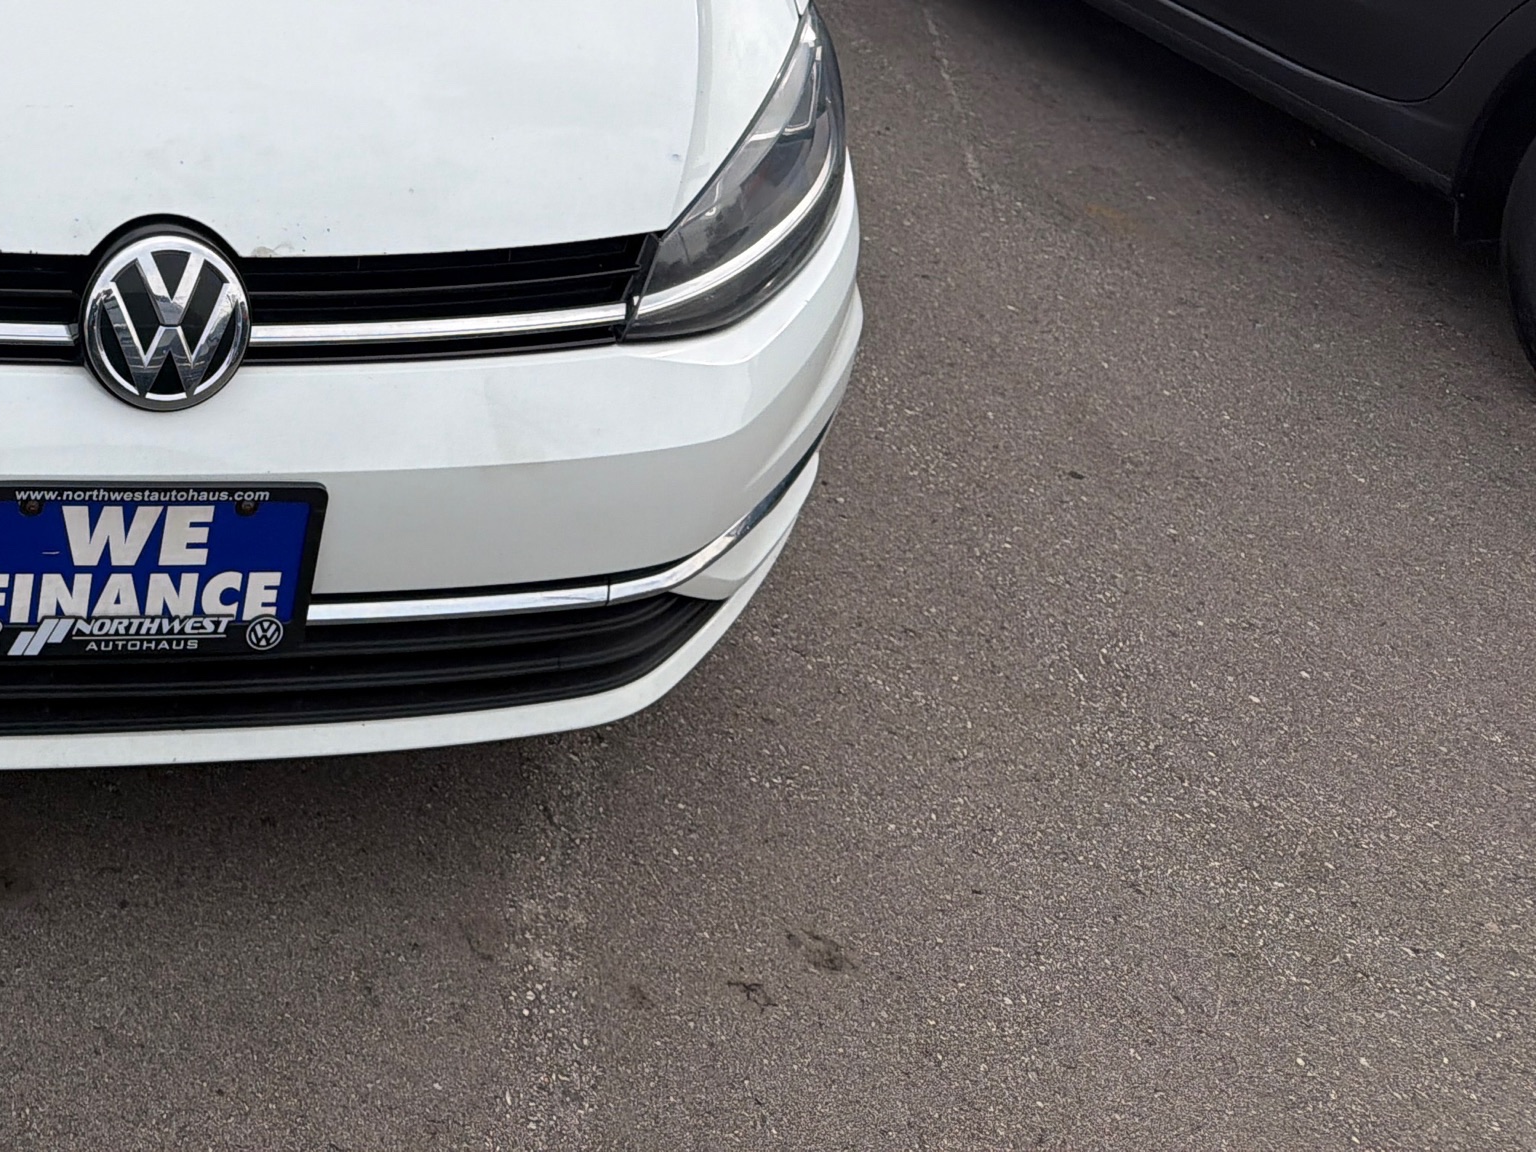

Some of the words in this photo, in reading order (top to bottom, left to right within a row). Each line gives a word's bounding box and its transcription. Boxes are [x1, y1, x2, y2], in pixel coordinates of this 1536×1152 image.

[15, 489, 270, 502] www.northwestautohaus.com
[62, 505, 215, 567] WE
[71, 616, 234, 636] NORTHWEST
[85, 639, 199, 652] AUTOHAUS
